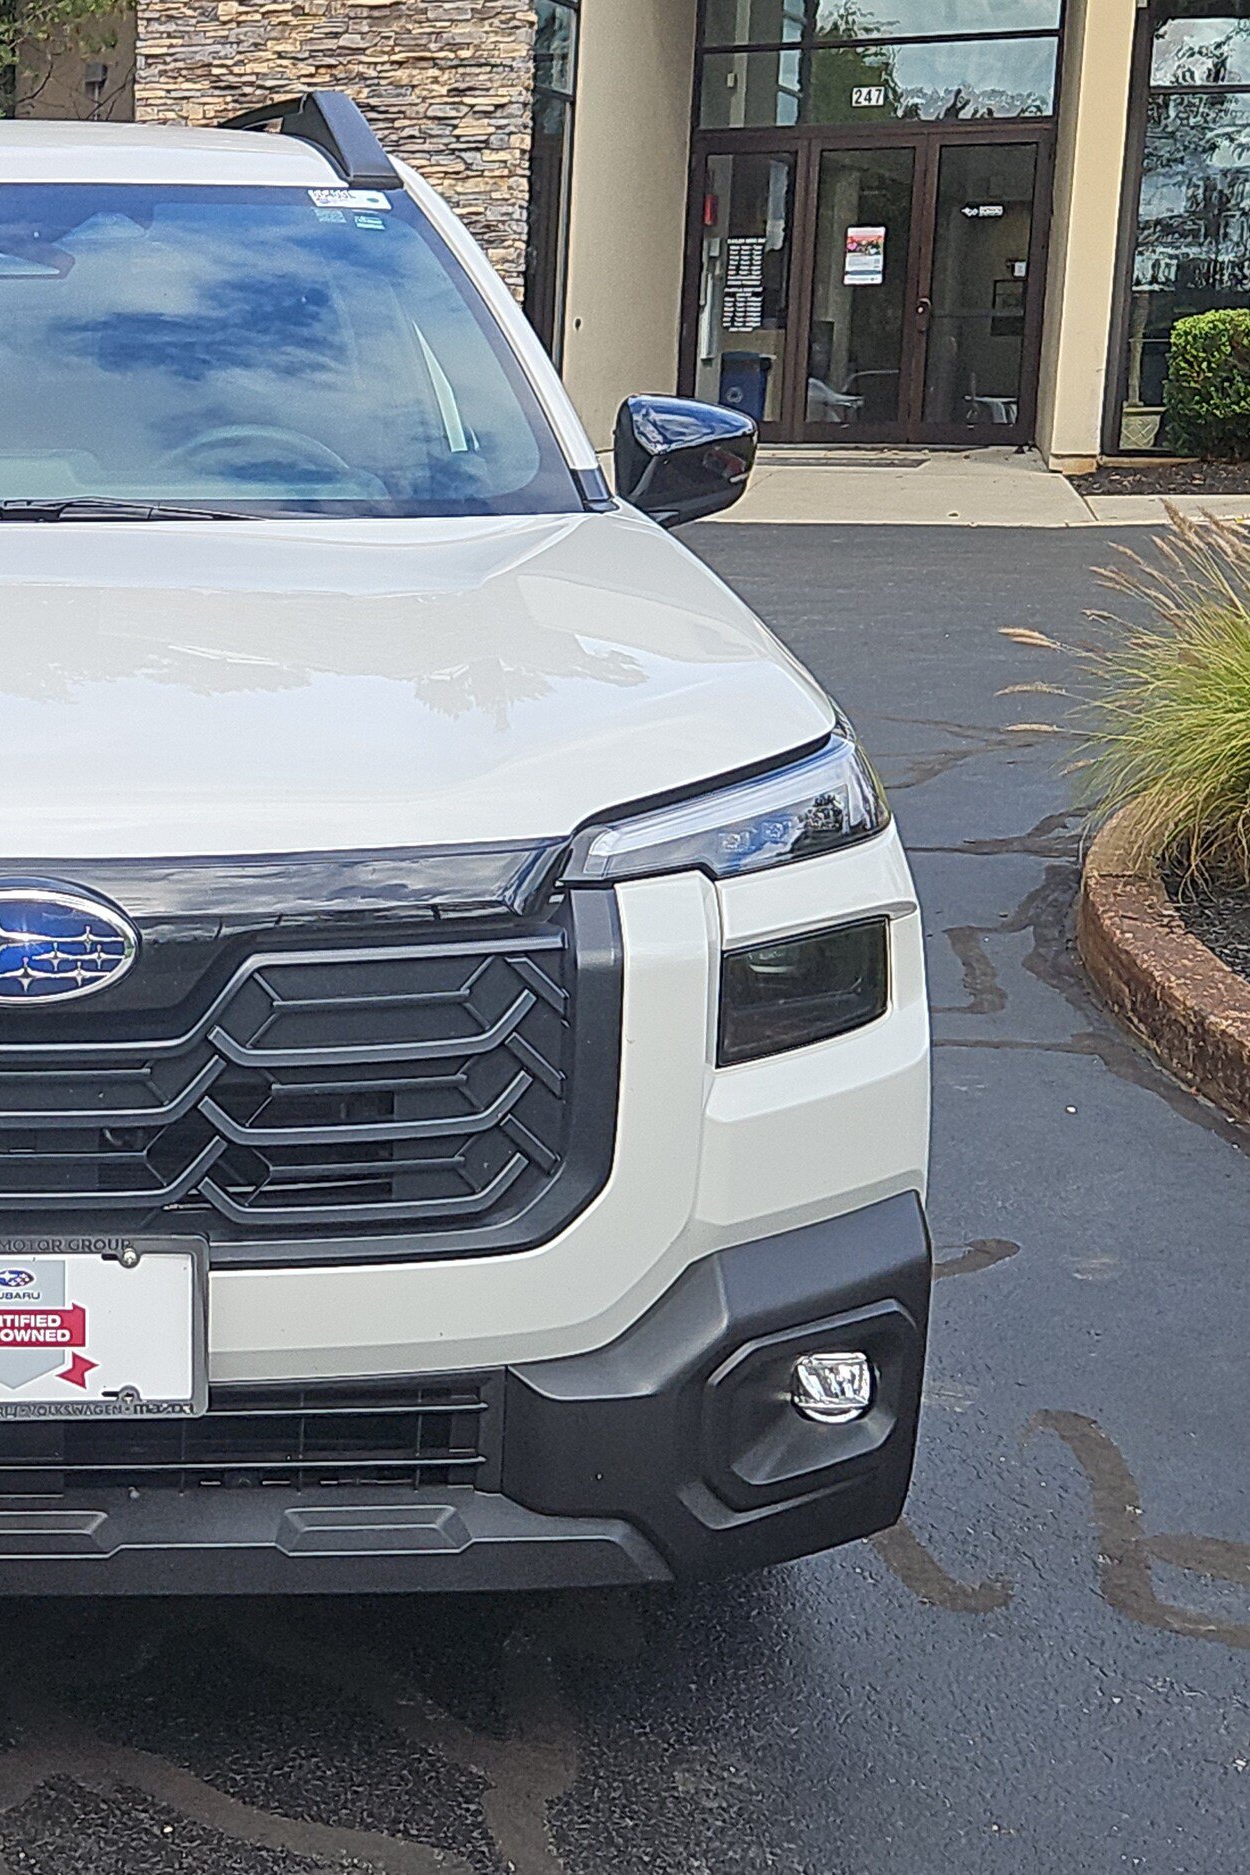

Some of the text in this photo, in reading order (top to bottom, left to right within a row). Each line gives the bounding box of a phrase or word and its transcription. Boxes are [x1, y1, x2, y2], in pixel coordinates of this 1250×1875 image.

[854, 88, 883, 105] 247
[68, 1238, 132, 1252] GROUP
[29, 1403, 122, 1417] VOLKSWAGEN
